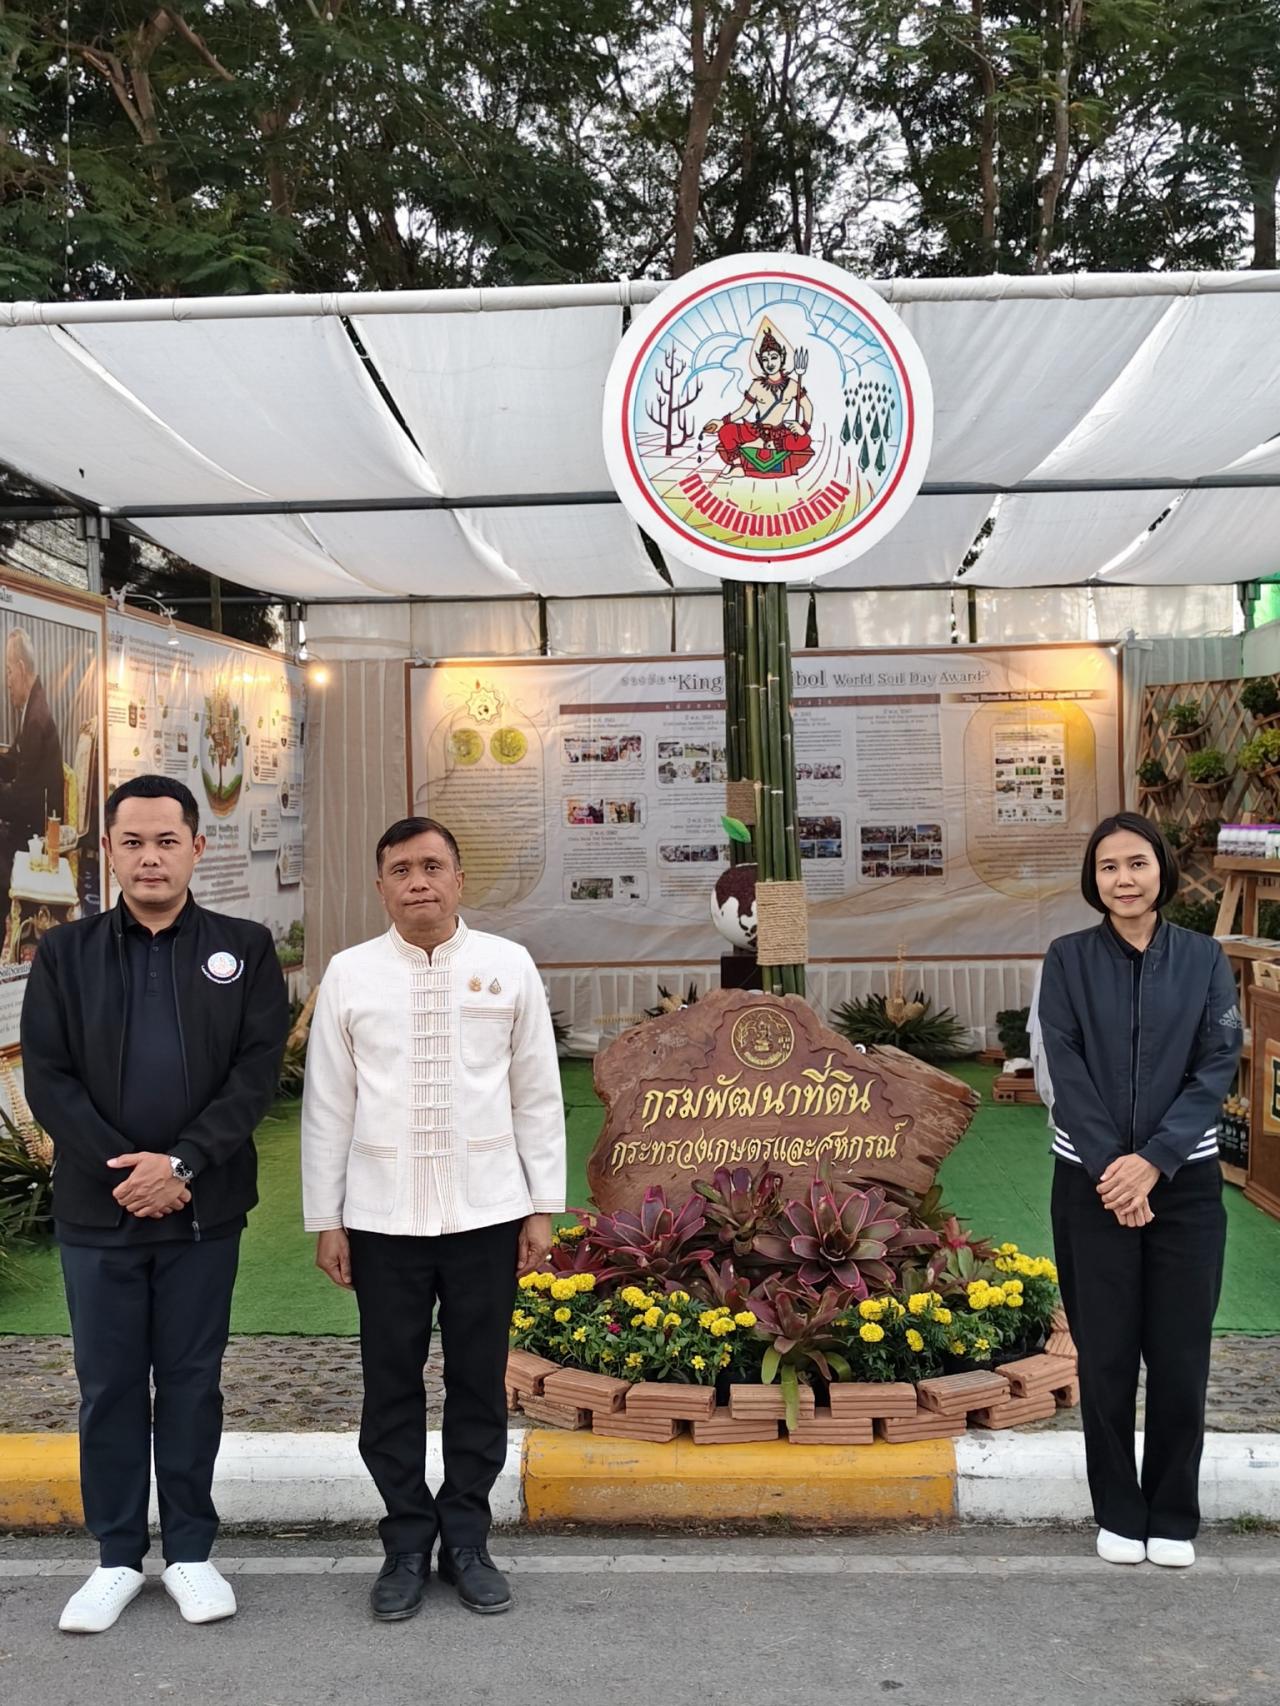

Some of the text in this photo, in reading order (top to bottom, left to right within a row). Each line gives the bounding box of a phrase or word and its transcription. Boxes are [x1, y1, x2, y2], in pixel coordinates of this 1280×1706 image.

[678, 473, 851, 537] กรมพัฒนาที่ดิน
[832, 672, 873, 686] World
[877, 672, 904, 686] Soil
[909, 671, 936, 688] Day
[641, 1052, 876, 1133] กรมพัฒนาที่ดิน
[610, 1119, 909, 1176] กระทรวงเกษตรและสหกรณ์
